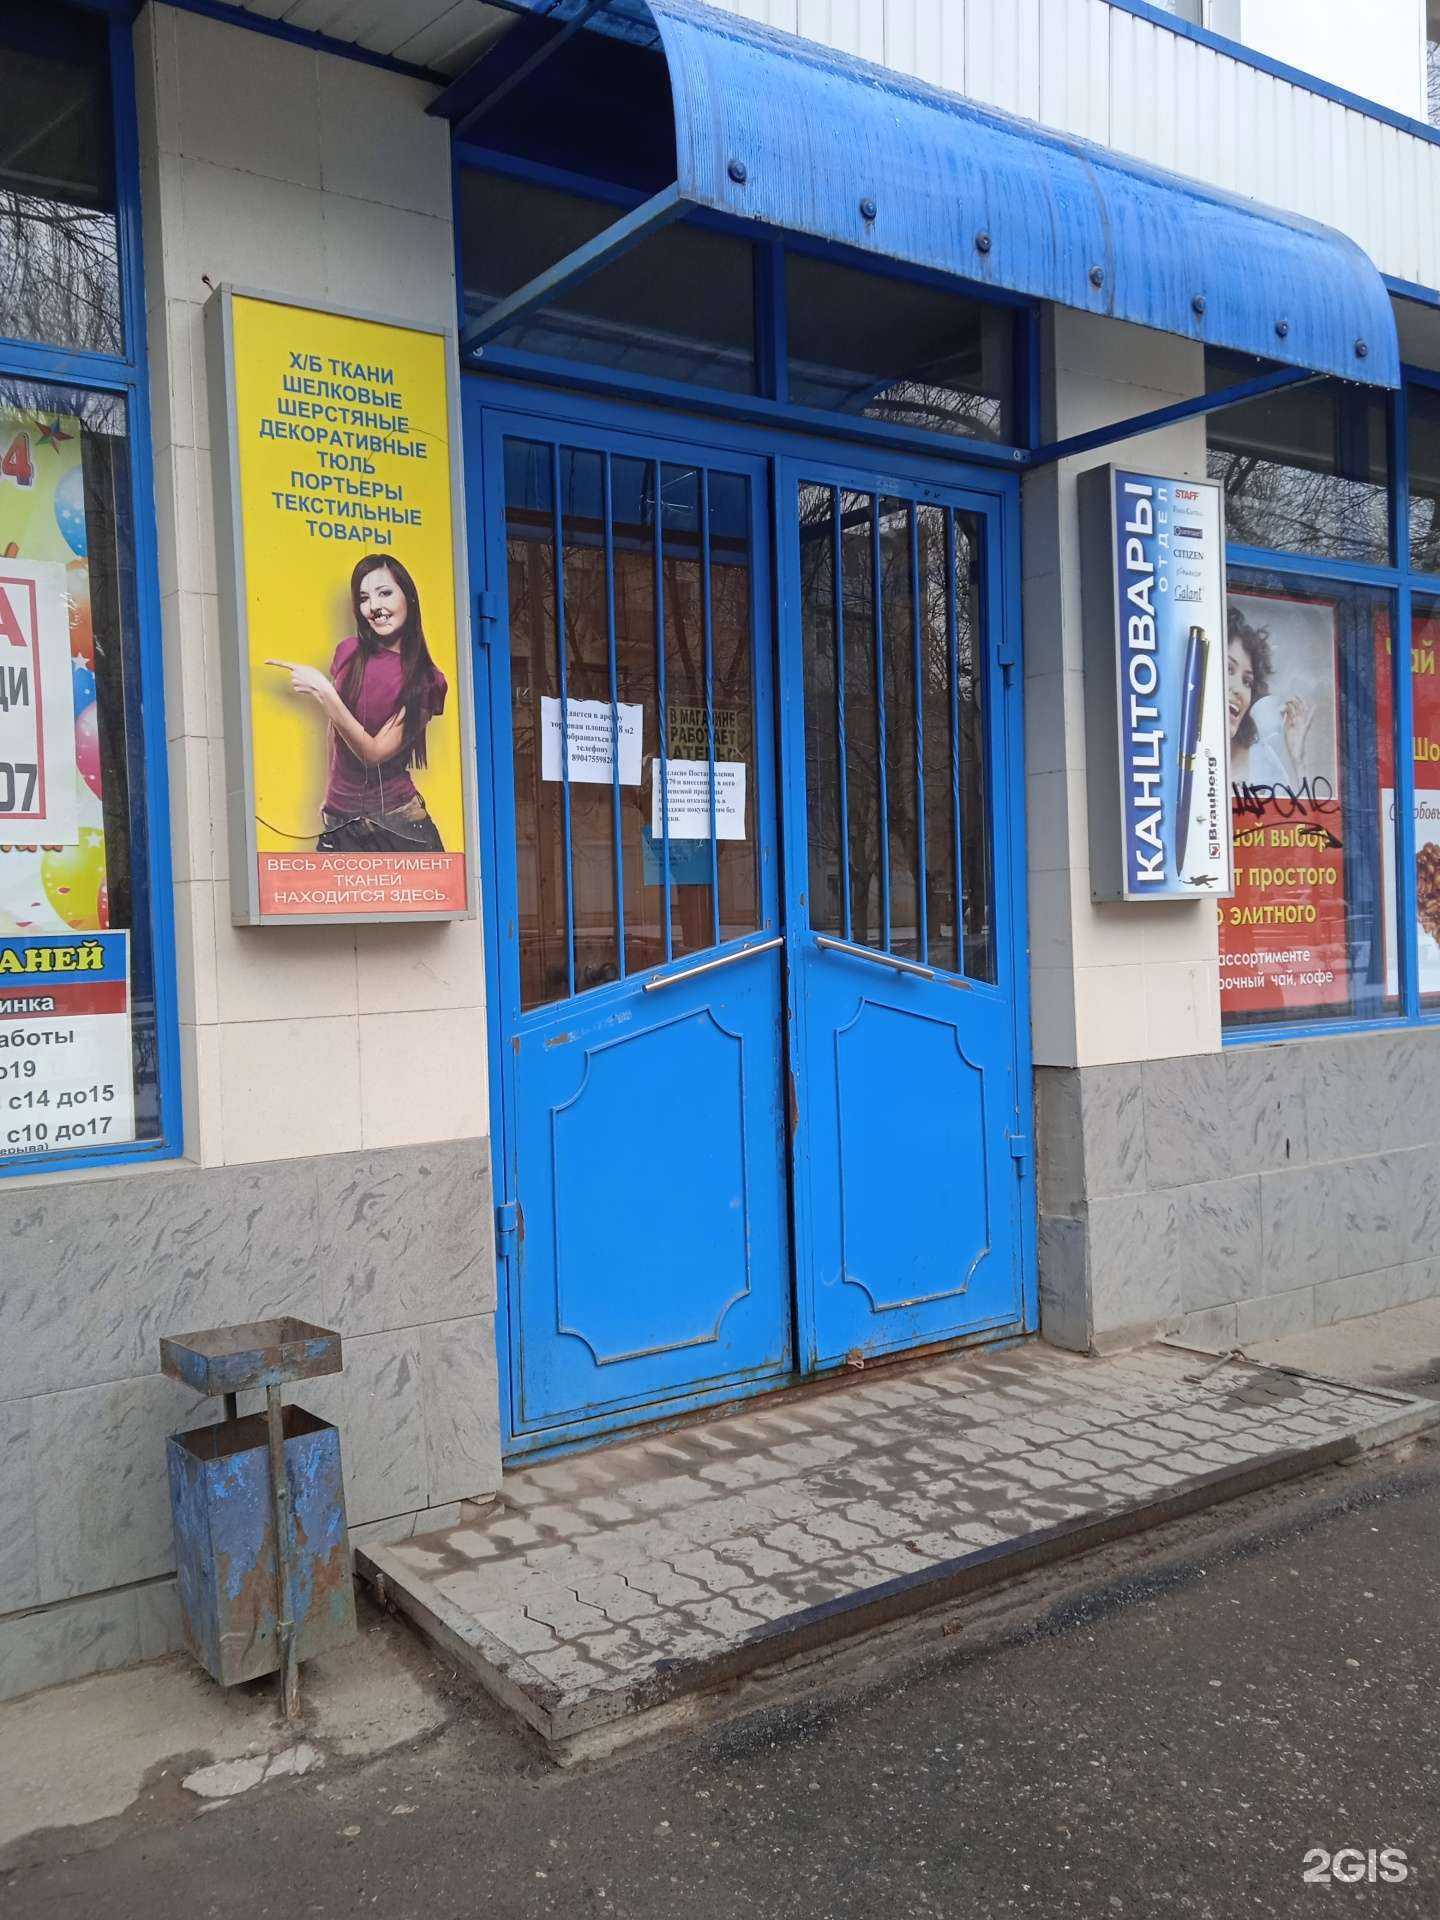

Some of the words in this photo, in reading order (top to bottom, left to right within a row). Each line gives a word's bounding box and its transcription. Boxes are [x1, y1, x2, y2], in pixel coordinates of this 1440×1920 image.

[289, 352, 322, 372] Х/Б
[328, 358, 394, 385] ТКАНИ
[283, 374, 402, 409] ШЕЛКОВЫЕ
[277, 397, 409, 433] ШЕРСТЯНЫЕ
[259, 418, 427, 459] ДЕКОРАТИВНЫЕ
[317, 451, 375, 474] ТЮЛЬ
[291, 471, 402, 501] ПОРТЬЕРЫ
[1175, 489, 1200, 501] STAFF
[272, 492, 422, 525] ТЕКСТИЛЬНЫЕ
[306, 520, 392, 545] ТОВАРЫ
[1158, 488, 1169, 592] ОТДЕЛ
[1173, 549, 1205, 560] CITIZEN
[1125, 483, 1164, 881] КАНЦТОВАРЫ
[669, 708, 677, 724] В
[680, 709, 736, 729] МАГАИНЕ
[671, 726, 736, 745] РАБОАЕТ
[1208, 757, 1218, 841] Brauberg
[267, 858, 317, 871] ВЕСЬ
[321, 858, 453, 871] АССОРТИМЕНТ
[333, 872, 402, 887] ТКАНЕЙ
[1249, 867, 1337, 892] простого
[274, 890, 386, 905] НАХОДИТСЯ
[390, 889, 450, 903] ЗДЕСЬ.
[1230, 904, 1317, 926] элитного
[1271, 969, 1297, 987] чай,
[1300, 970, 1334, 987] кофе
[9, 1089, 50, 1110] с14
[57, 1084, 115, 1108] до15
[7, 1123, 48, 1143] с10
[55, 1116, 112, 1142] до17
